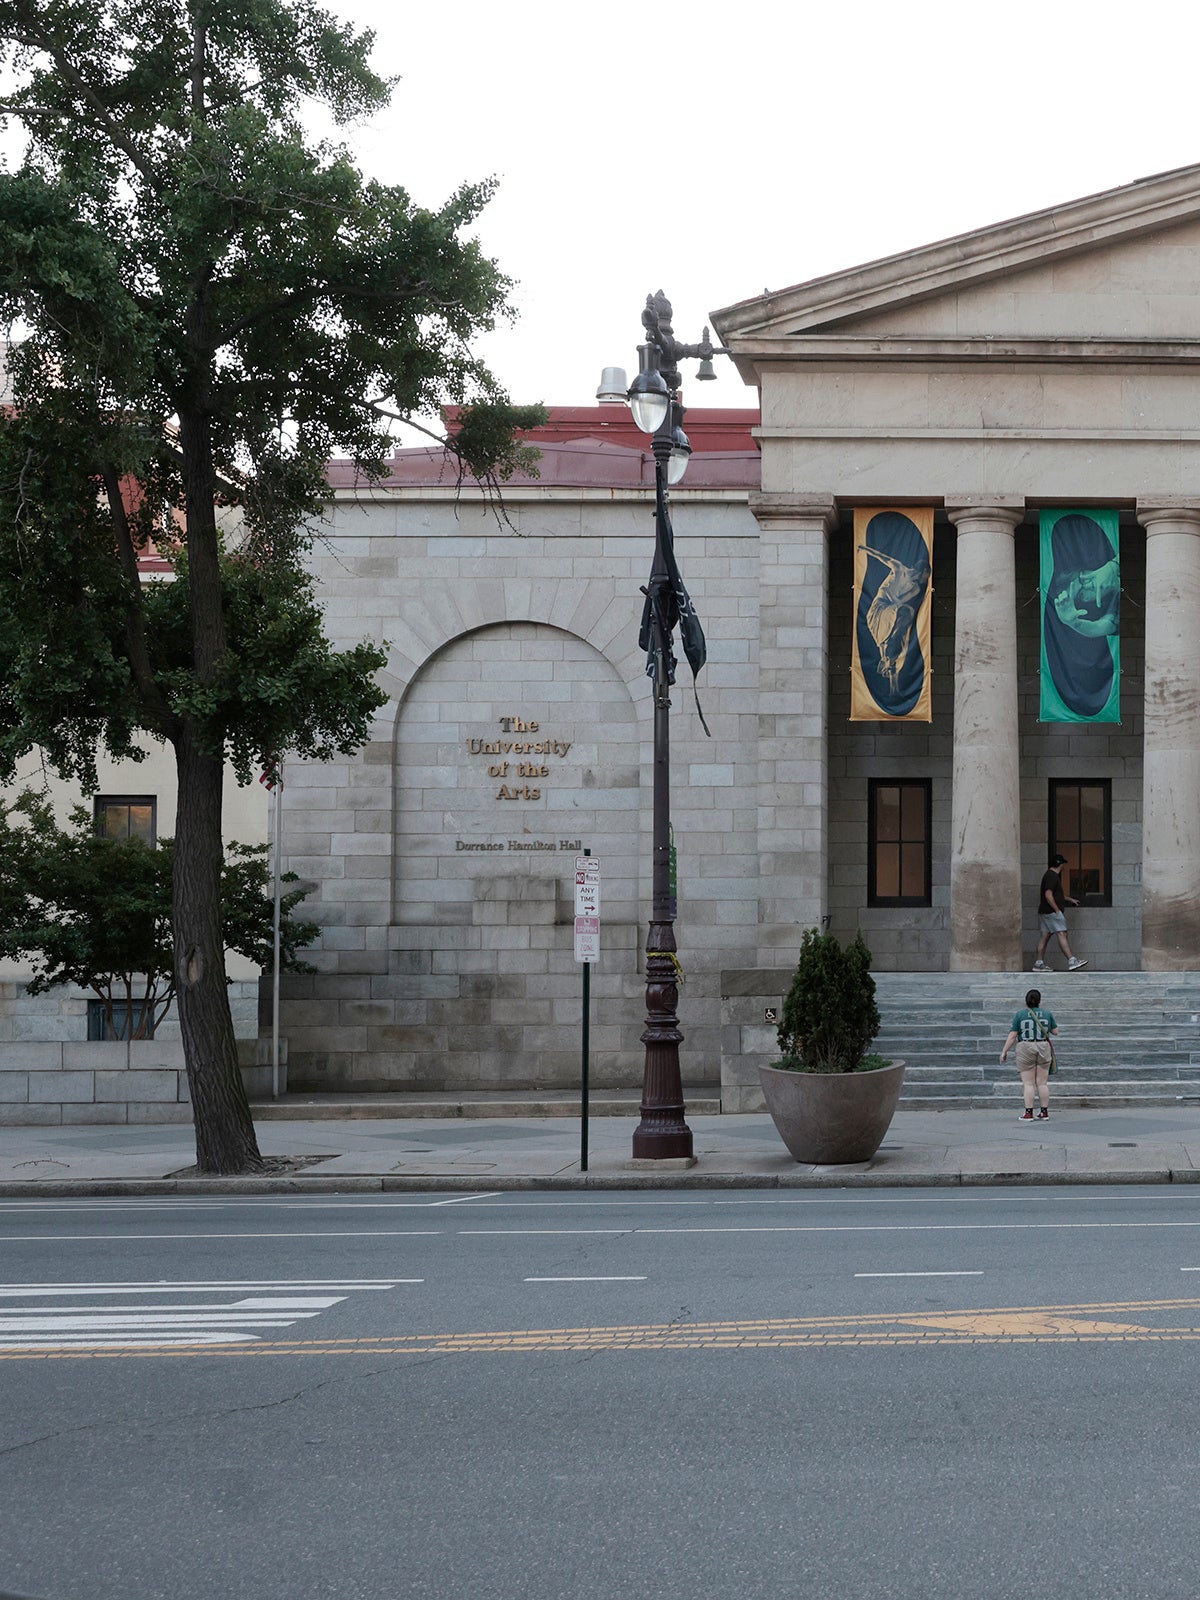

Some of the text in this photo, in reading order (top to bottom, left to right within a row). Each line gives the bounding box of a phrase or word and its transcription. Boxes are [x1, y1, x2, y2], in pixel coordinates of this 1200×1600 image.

[500, 716, 539, 733] The
[466, 738, 573, 758] University
[487, 761, 550, 777] of the
[495, 784, 541, 800] Arts
[456, 840, 582, 851] Dorrance Hamilton Hall
[1021, 1019, 1048, 1040] 86
